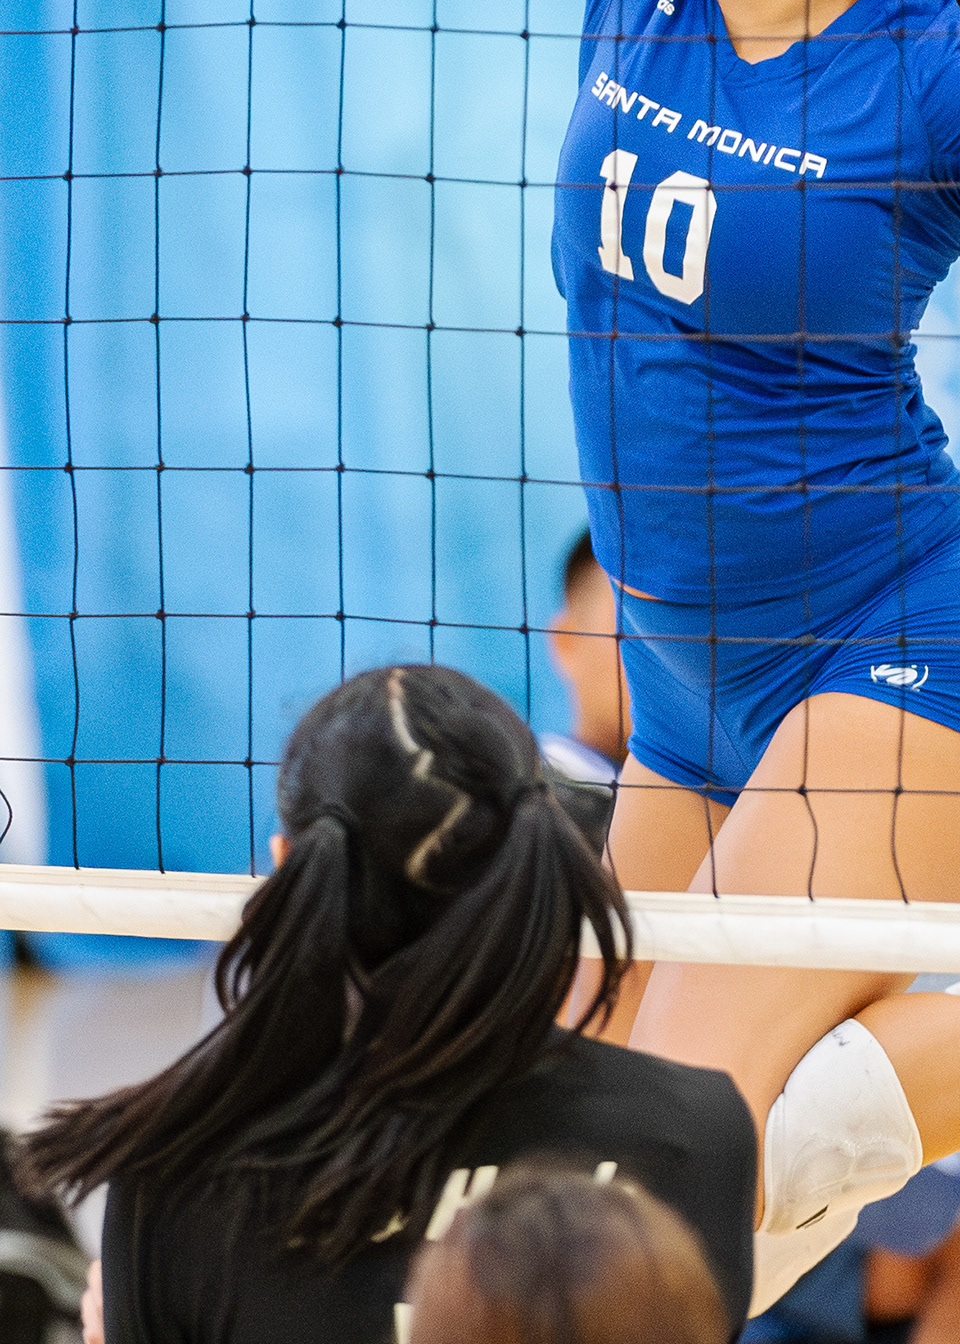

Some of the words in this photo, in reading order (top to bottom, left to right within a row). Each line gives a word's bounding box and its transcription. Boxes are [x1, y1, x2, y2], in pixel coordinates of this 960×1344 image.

[591, 72, 682, 134] SANTA
[687, 119, 828, 179] MONICA
[598, 148, 718, 305] 10
